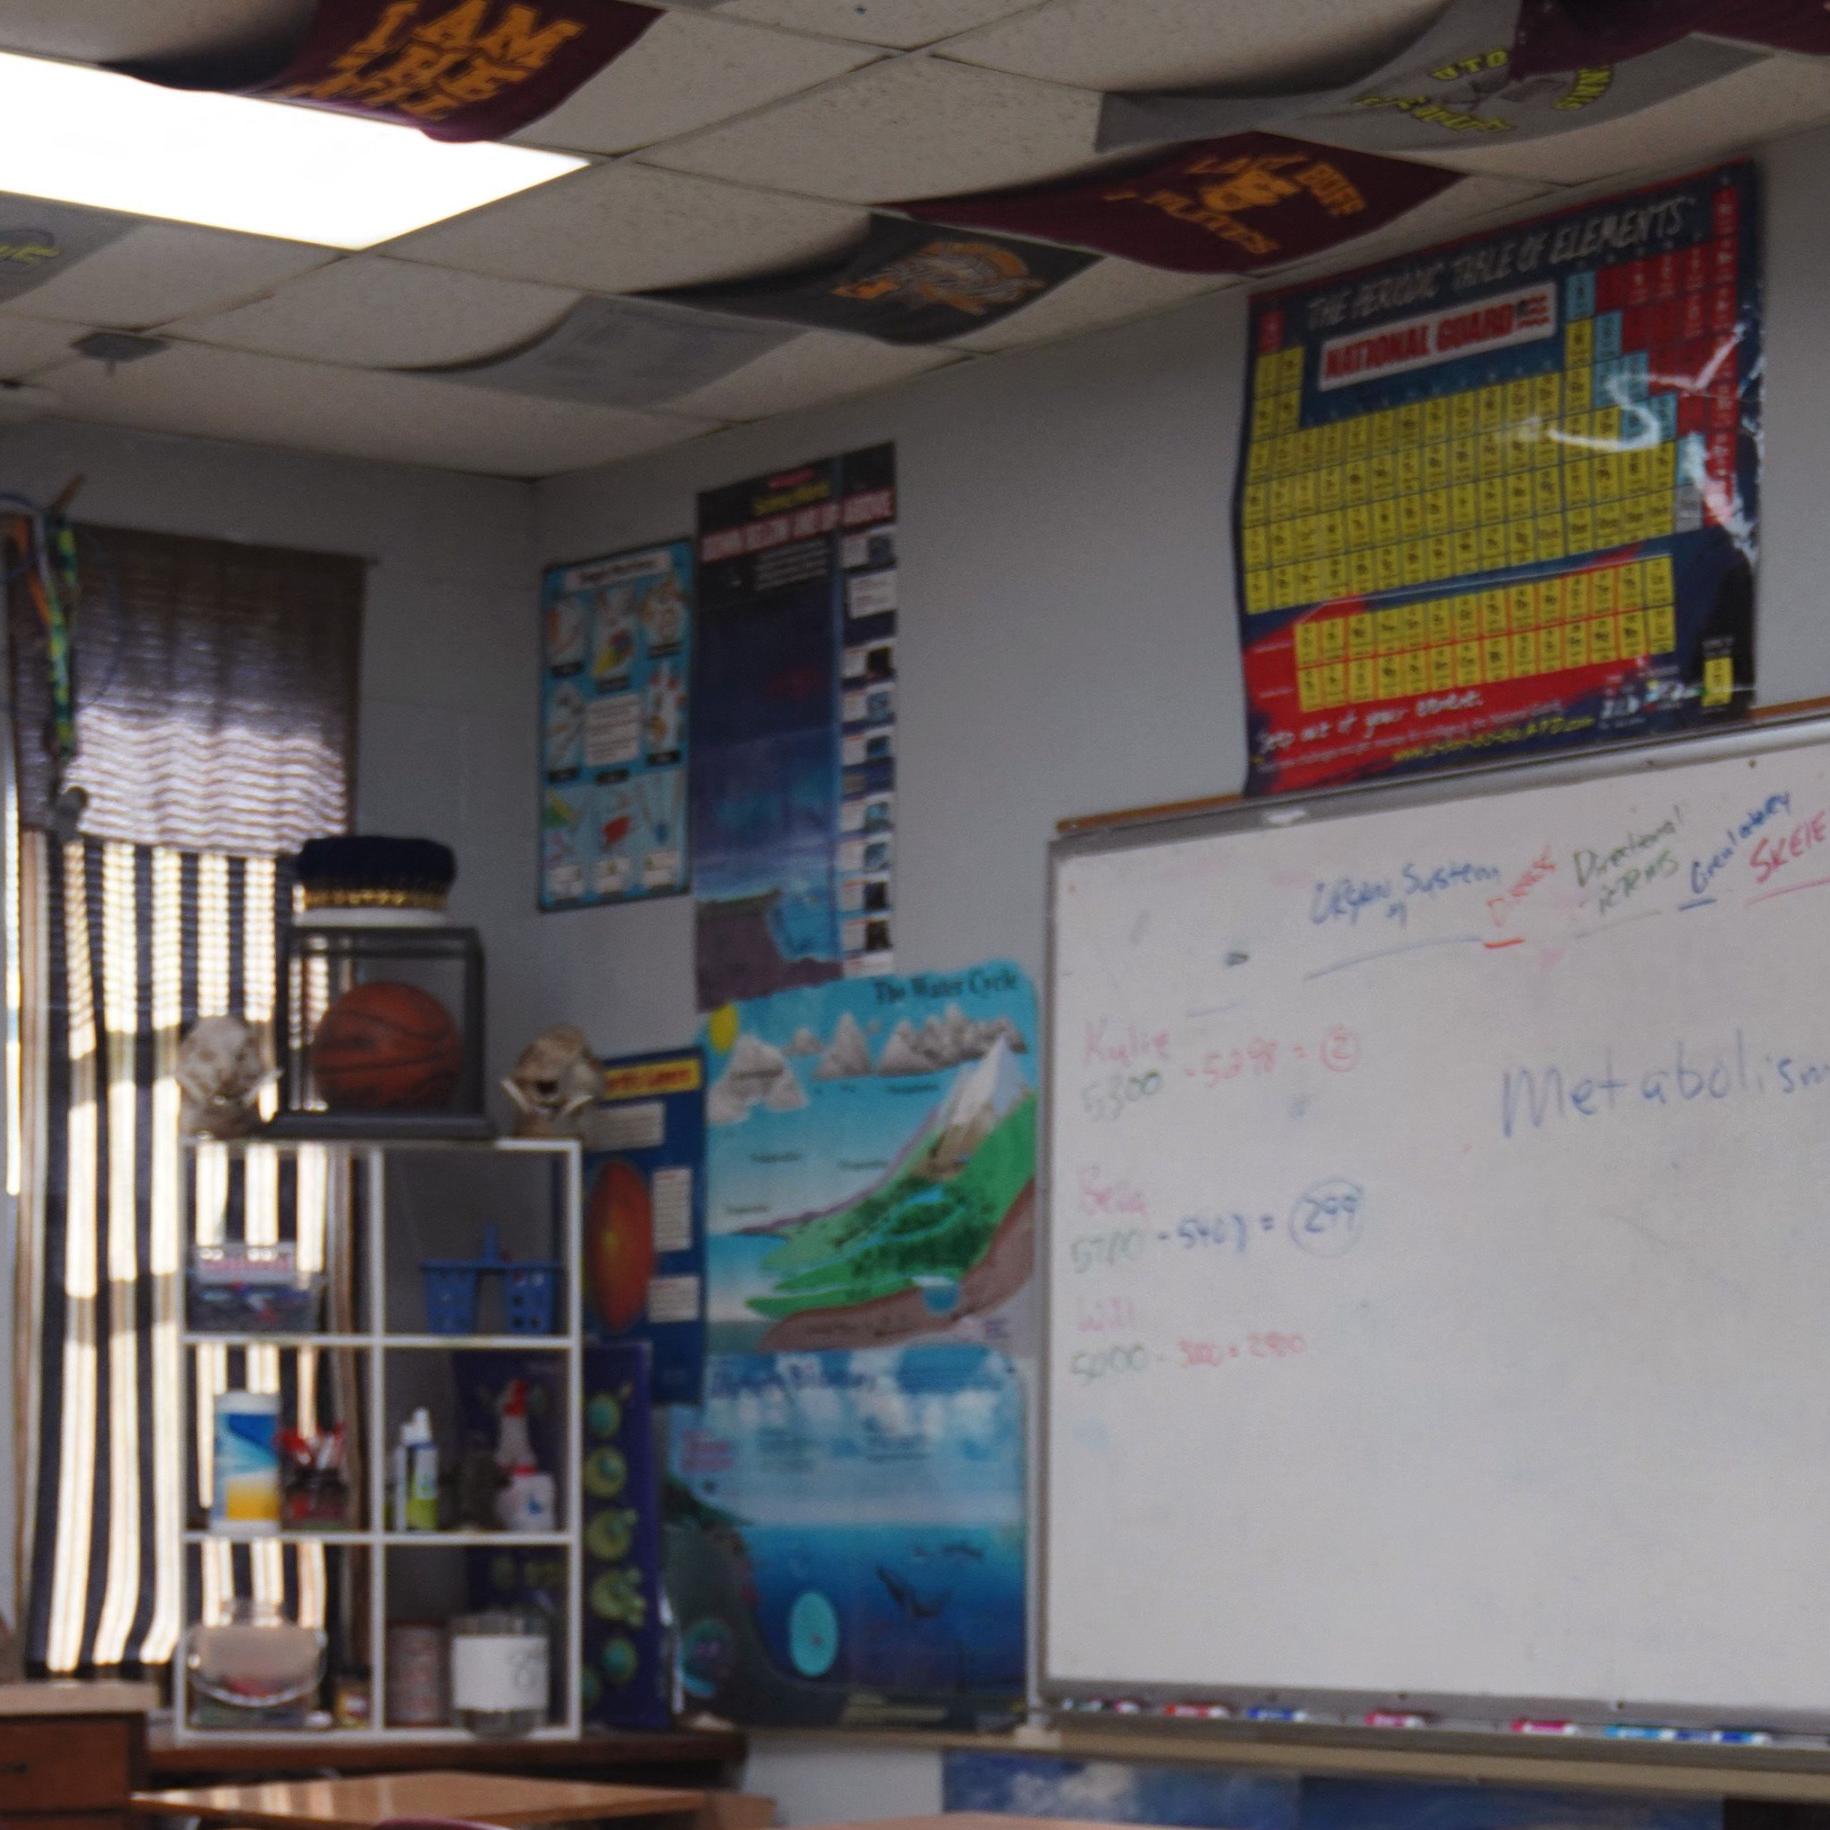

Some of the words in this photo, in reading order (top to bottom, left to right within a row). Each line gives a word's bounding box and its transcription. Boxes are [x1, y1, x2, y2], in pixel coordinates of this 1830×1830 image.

[1352, 262, 1444, 316] PERIODIC
[1455, 249, 1515, 295] TABLE
[1552, 199, 1686, 260] ELEMENTS
[1326, 325, 1431, 381] NATIONAL
[1437, 304, 1515, 351] GUARD
